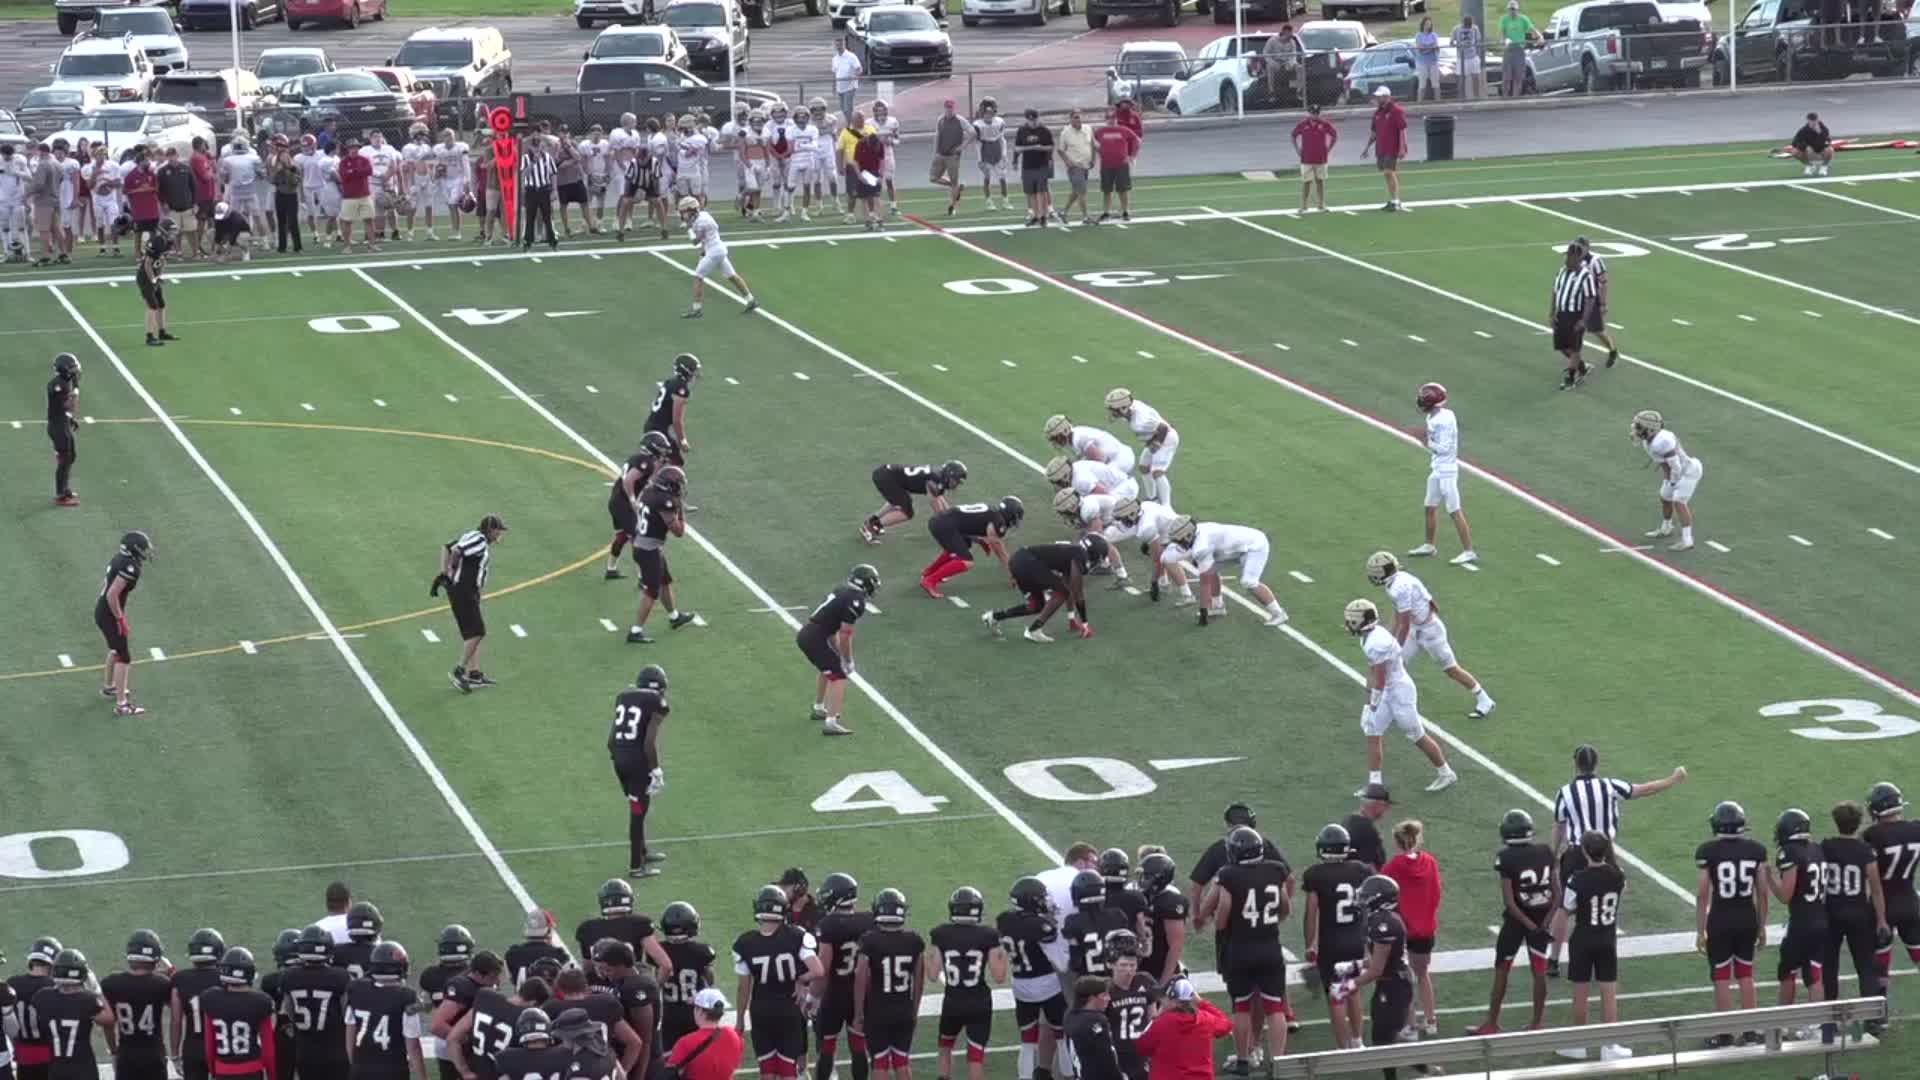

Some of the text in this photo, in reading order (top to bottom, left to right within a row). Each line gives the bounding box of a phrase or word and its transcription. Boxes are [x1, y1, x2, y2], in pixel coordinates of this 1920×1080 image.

[615, 704, 642, 740] 23
[1717, 860, 1757, 899] 85
[1884, 842, 1920, 880] 77
[1241, 884, 1281, 929] 42
[1590, 892, 1619, 926] 18
[751, 952, 797, 985] 70
[881, 955, 912, 993] 15
[944, 949, 984, 987] 63
[16, 1000, 40, 1039] 11
[115, 1002, 155, 1036] 84
[290, 989, 333, 1032] 57
[354, 1008, 391, 1051] 74
[1119, 1006, 1145, 1040] 12
[48, 1019, 80, 1057] 17
[212, 1018, 250, 1055] 38
